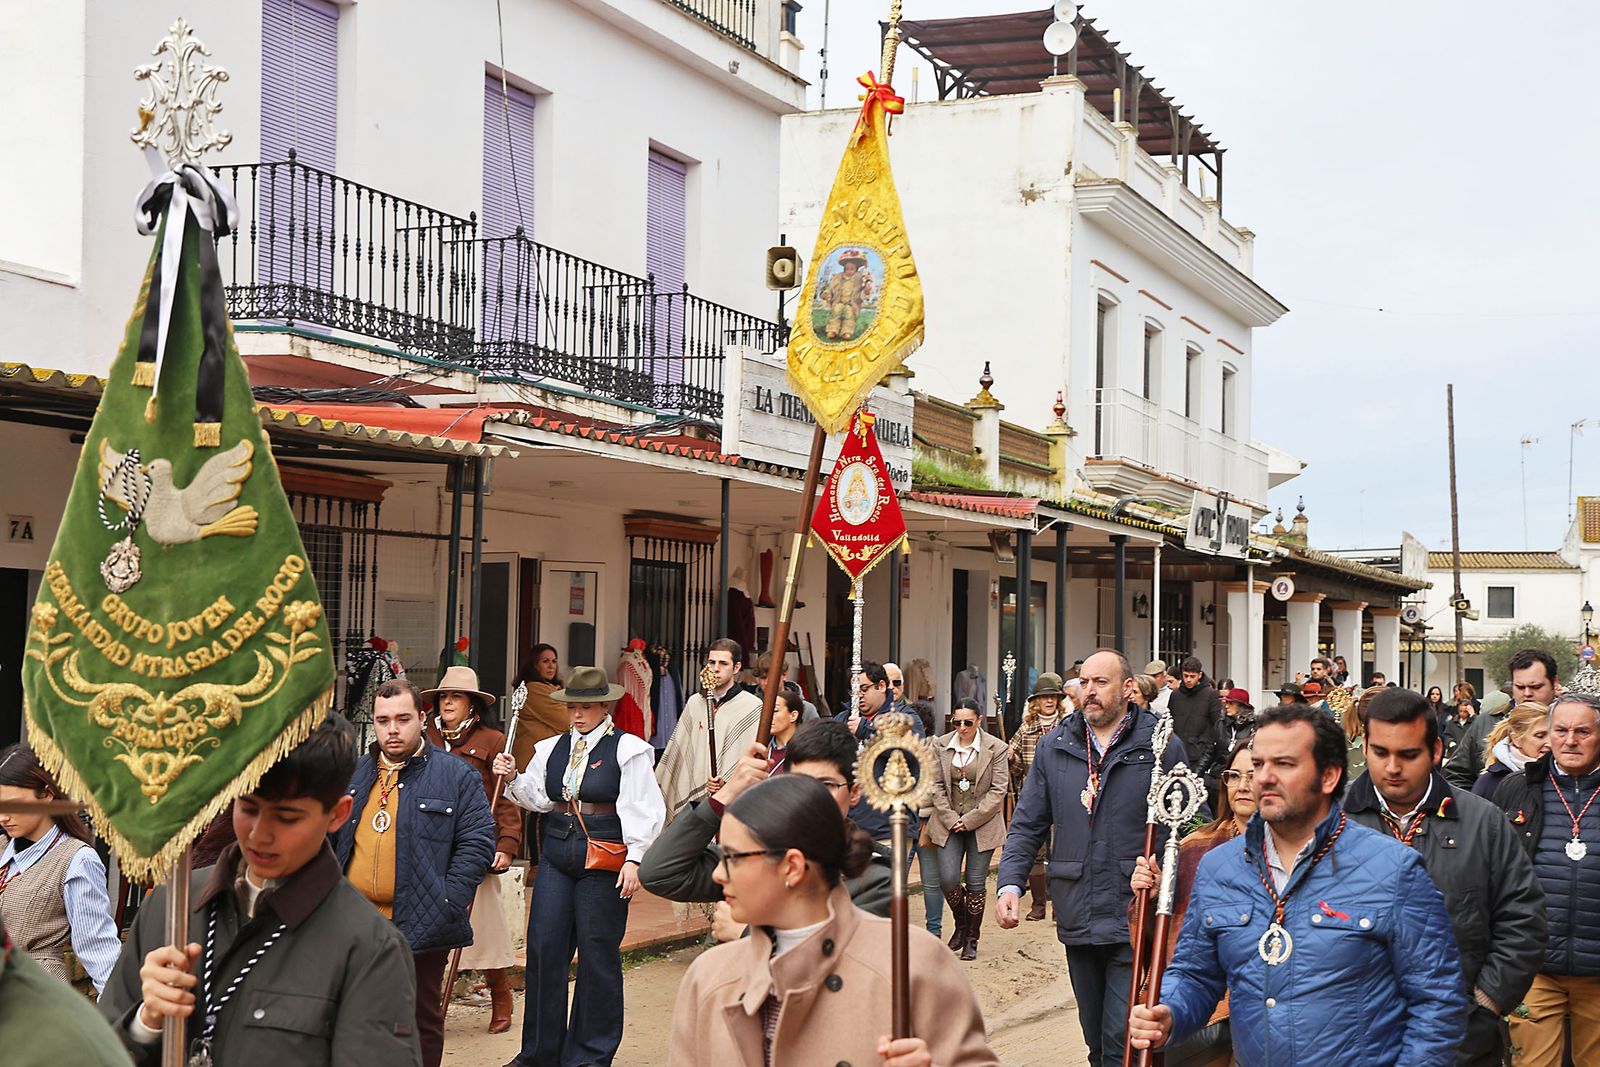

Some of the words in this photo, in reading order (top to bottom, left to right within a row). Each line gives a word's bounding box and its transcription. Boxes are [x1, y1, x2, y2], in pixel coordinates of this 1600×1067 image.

[854, 196, 917, 280] GRUPO
[755, 384, 774, 414] LA
[828, 467, 842, 523] Hermandad
[877, 476, 887, 491] del
[831, 528, 880, 542] Valladolid
[46, 559, 132, 668] HERMANDAD
[221, 610, 266, 652] DEL
[255, 554, 305, 620] ROCIO
[101, 593, 164, 644] GRUPO
[165, 594, 237, 650] JOVEN
[111, 714, 208, 750] BORMUJOS
